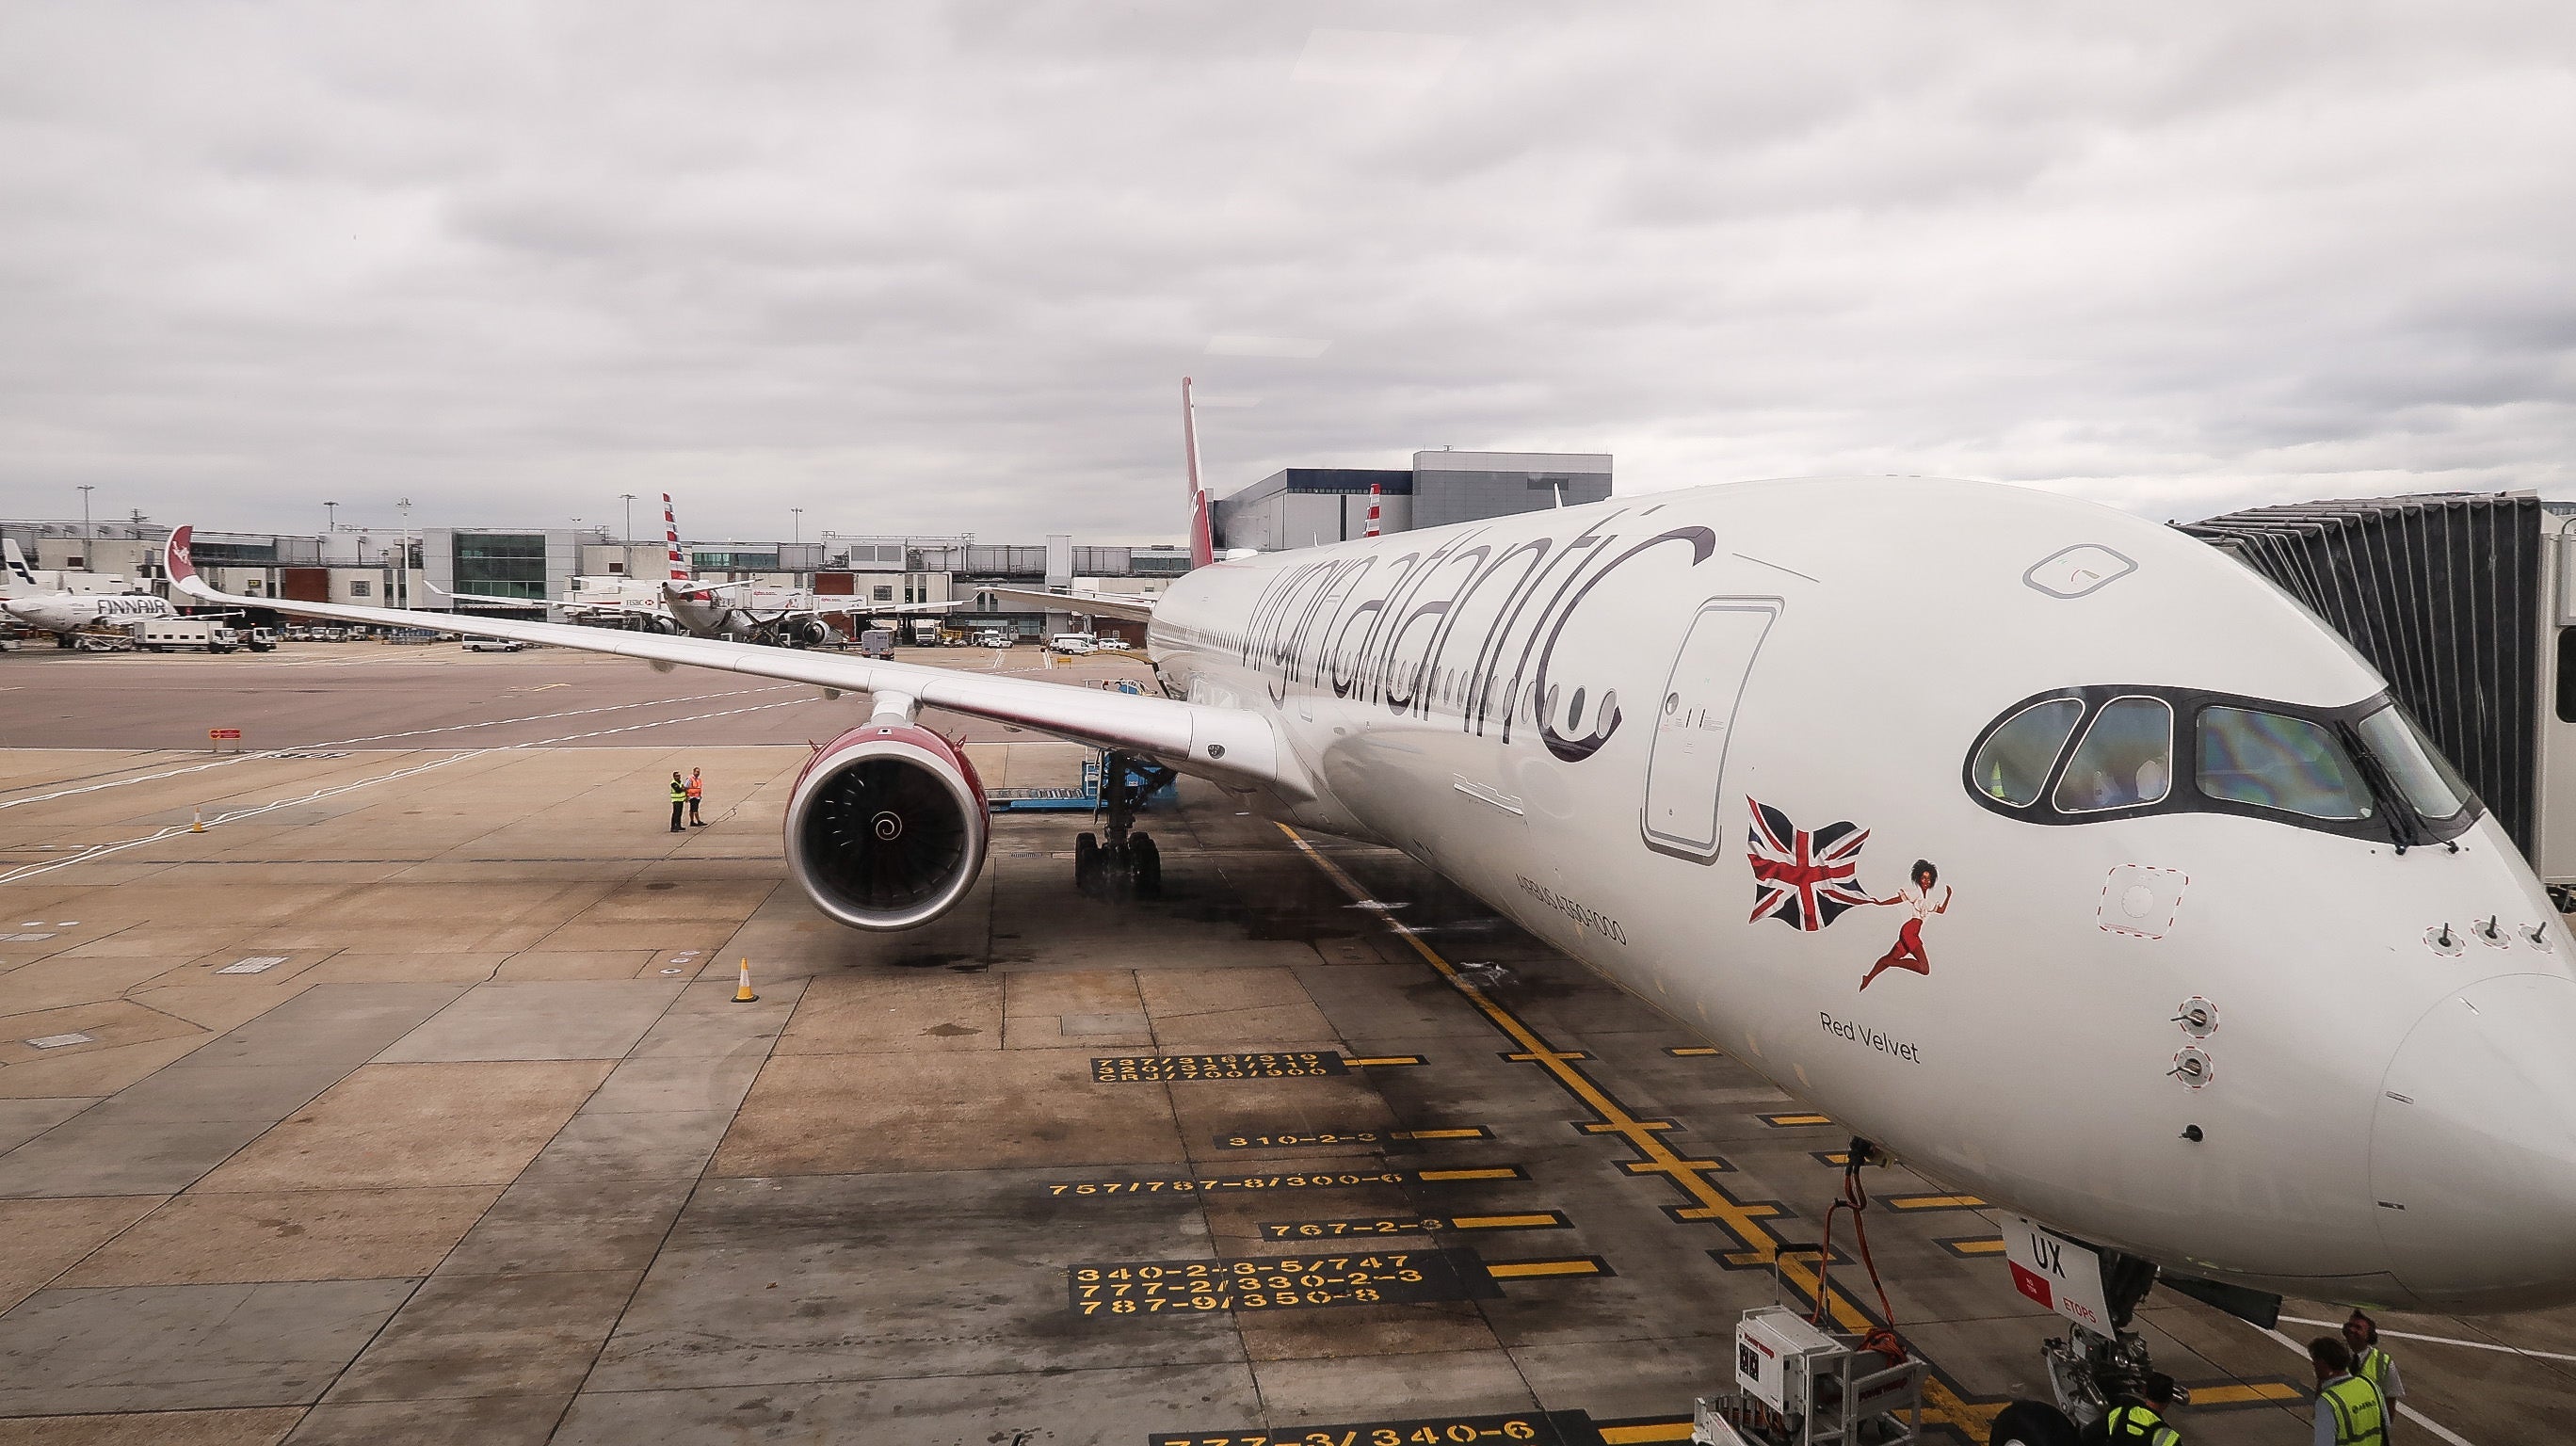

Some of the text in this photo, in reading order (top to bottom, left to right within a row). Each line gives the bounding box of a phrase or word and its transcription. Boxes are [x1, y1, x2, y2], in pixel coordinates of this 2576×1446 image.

[98, 599, 167, 615] FINNAIR
[1331, 505, 1715, 763] atlantic
[1820, 1011, 1920, 1065] Red Velvet
[1099, 1068, 1327, 1082] CRJ/700/900
[1229, 1133, 1377, 1147] 310-2-3
[1077, 1255, 1409, 1281] 340-2-3-5/747
[2031, 1233, 2066, 1279] UX
[1079, 1269, 1423, 1297] 777-2/330-2-3
[1079, 1292, 1380, 1315] 787-9/350-8
[2062, 1296, 2097, 1324] ETOPS
[1164, 1421, 1535, 1446] 7-3/340-6
